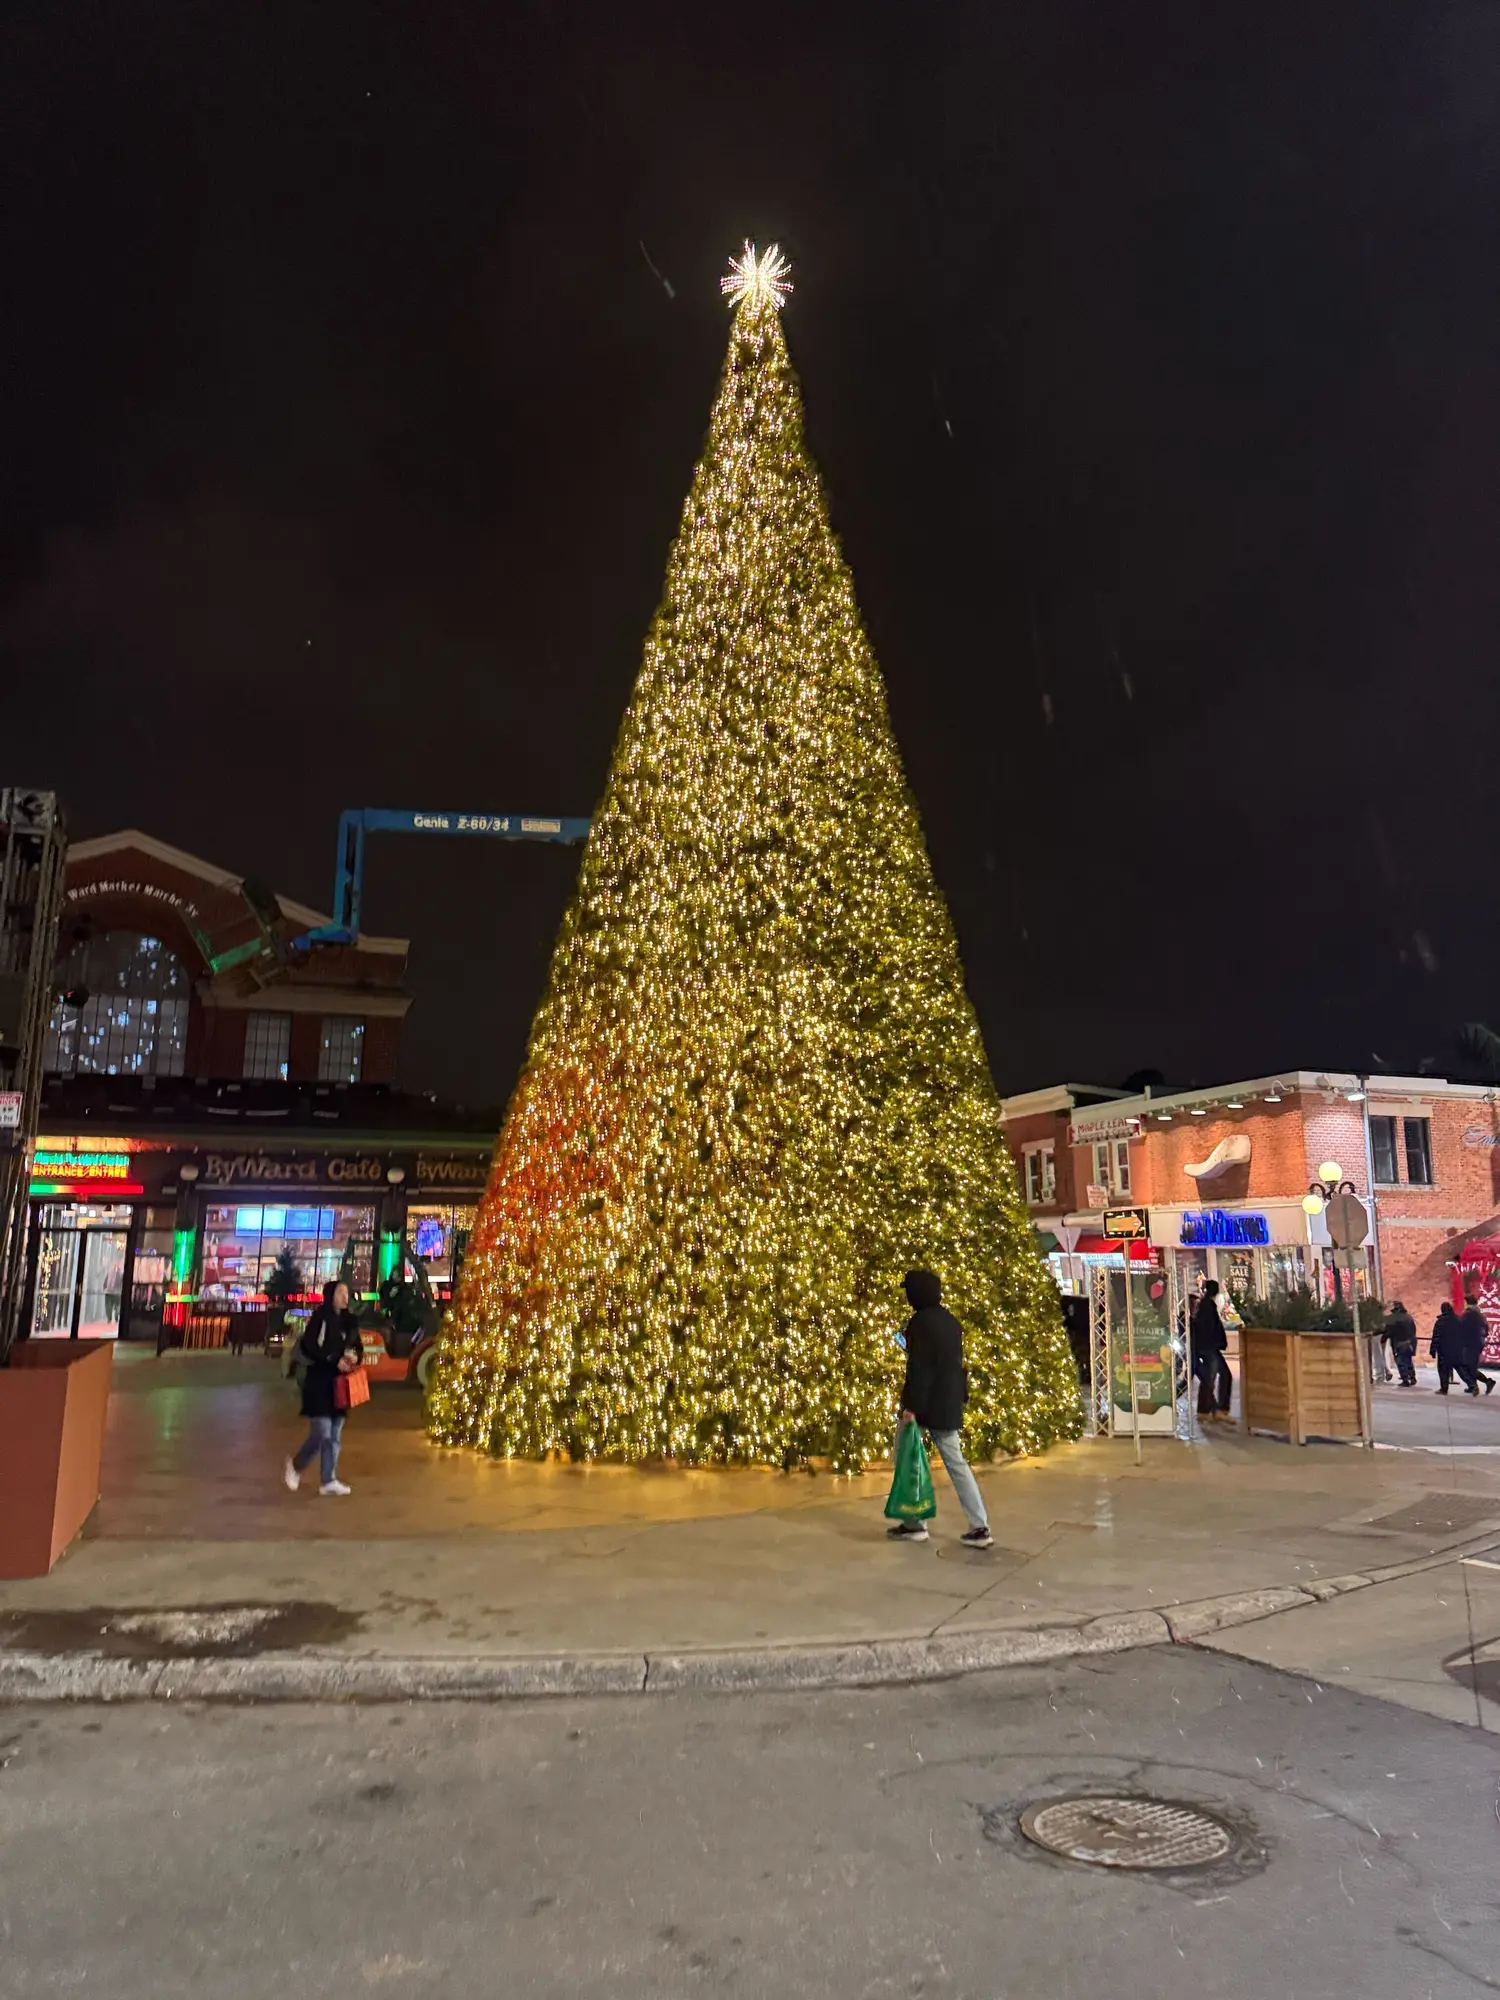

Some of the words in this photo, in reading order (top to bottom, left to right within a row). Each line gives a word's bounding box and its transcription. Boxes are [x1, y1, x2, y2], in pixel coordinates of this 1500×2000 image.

[413, 814, 450, 828] Genie
[457, 815, 510, 831] Z-60/34
[1077, 1119, 1104, 1134] MAPLE
[204, 1155, 317, 1184] ByWard
[327, 1157, 382, 1181] Café
[416, 1160, 490, 1181] ByWar
[1230, 1268, 1249, 1277] SALE
